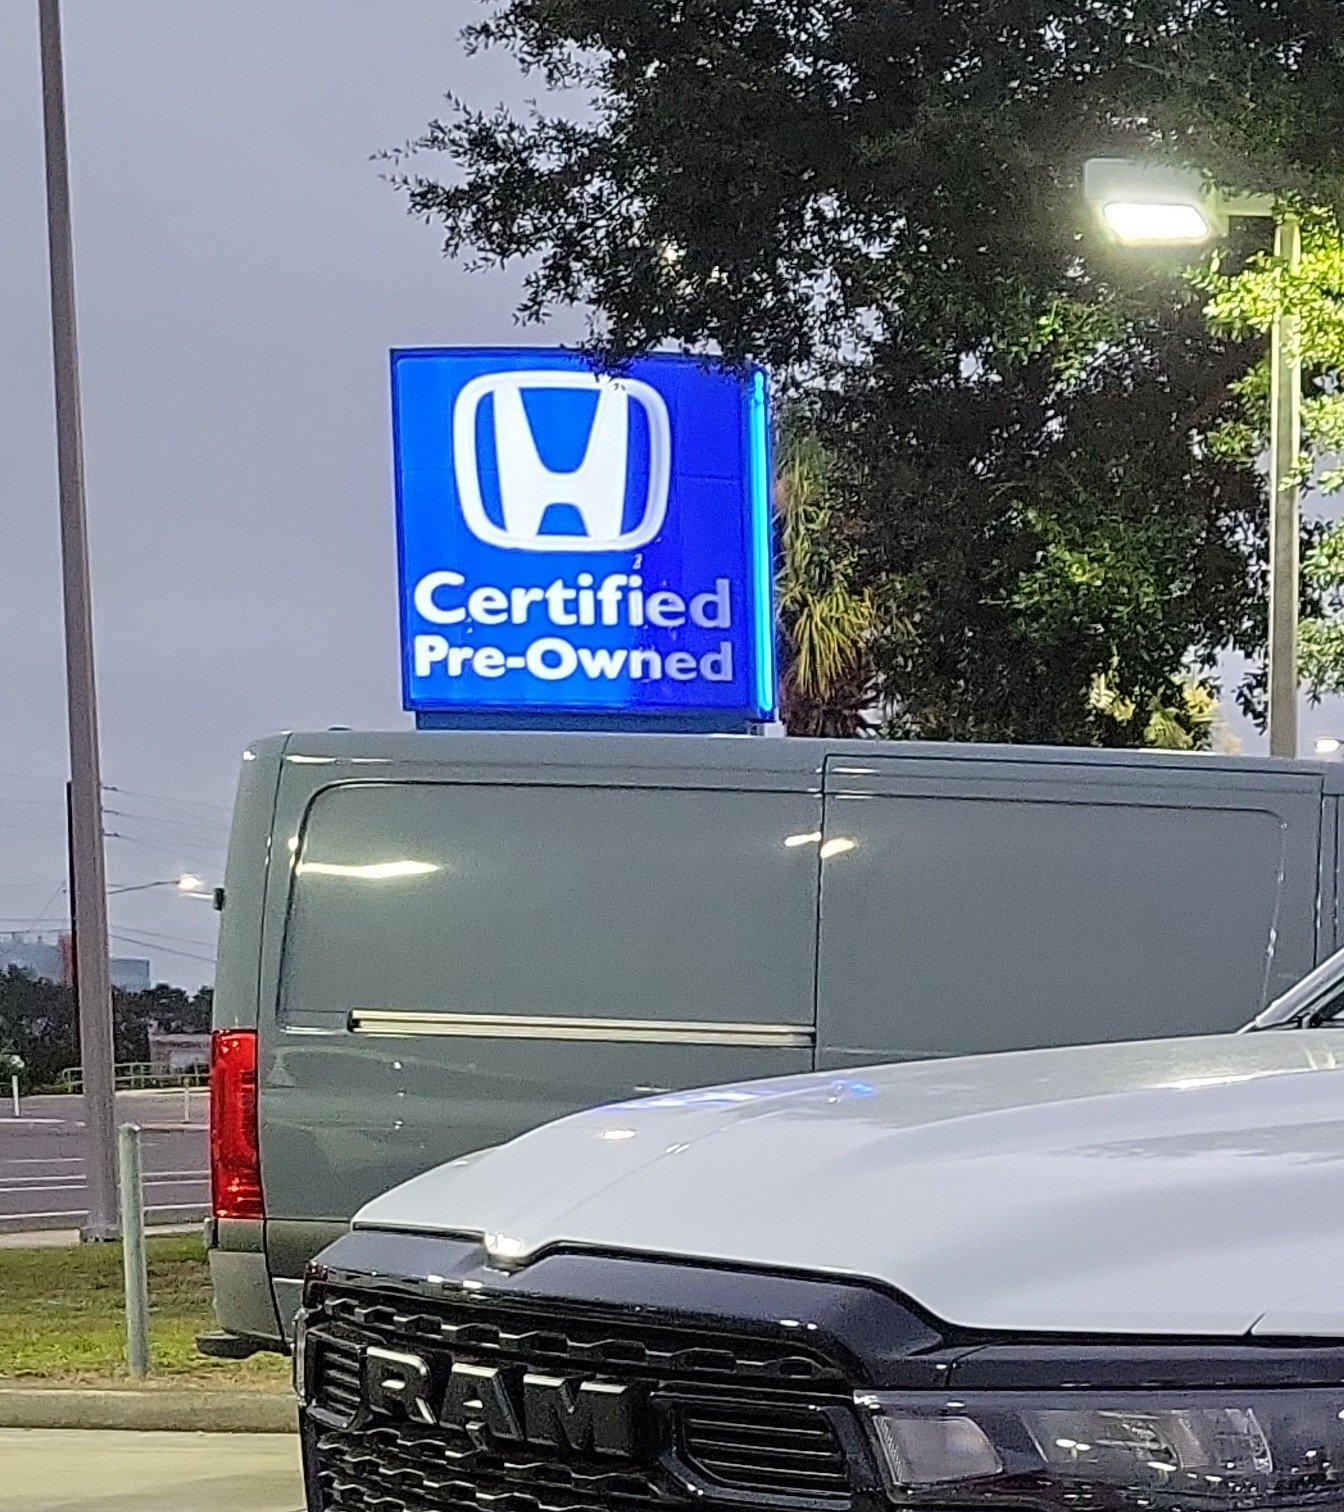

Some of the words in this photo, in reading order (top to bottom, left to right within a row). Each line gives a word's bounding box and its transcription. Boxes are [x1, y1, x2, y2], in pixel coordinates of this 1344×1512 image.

[413, 570, 732, 629] Certified
[413, 634, 734, 682] Pre-Owned
[363, 1345, 634, 1457] RAM
